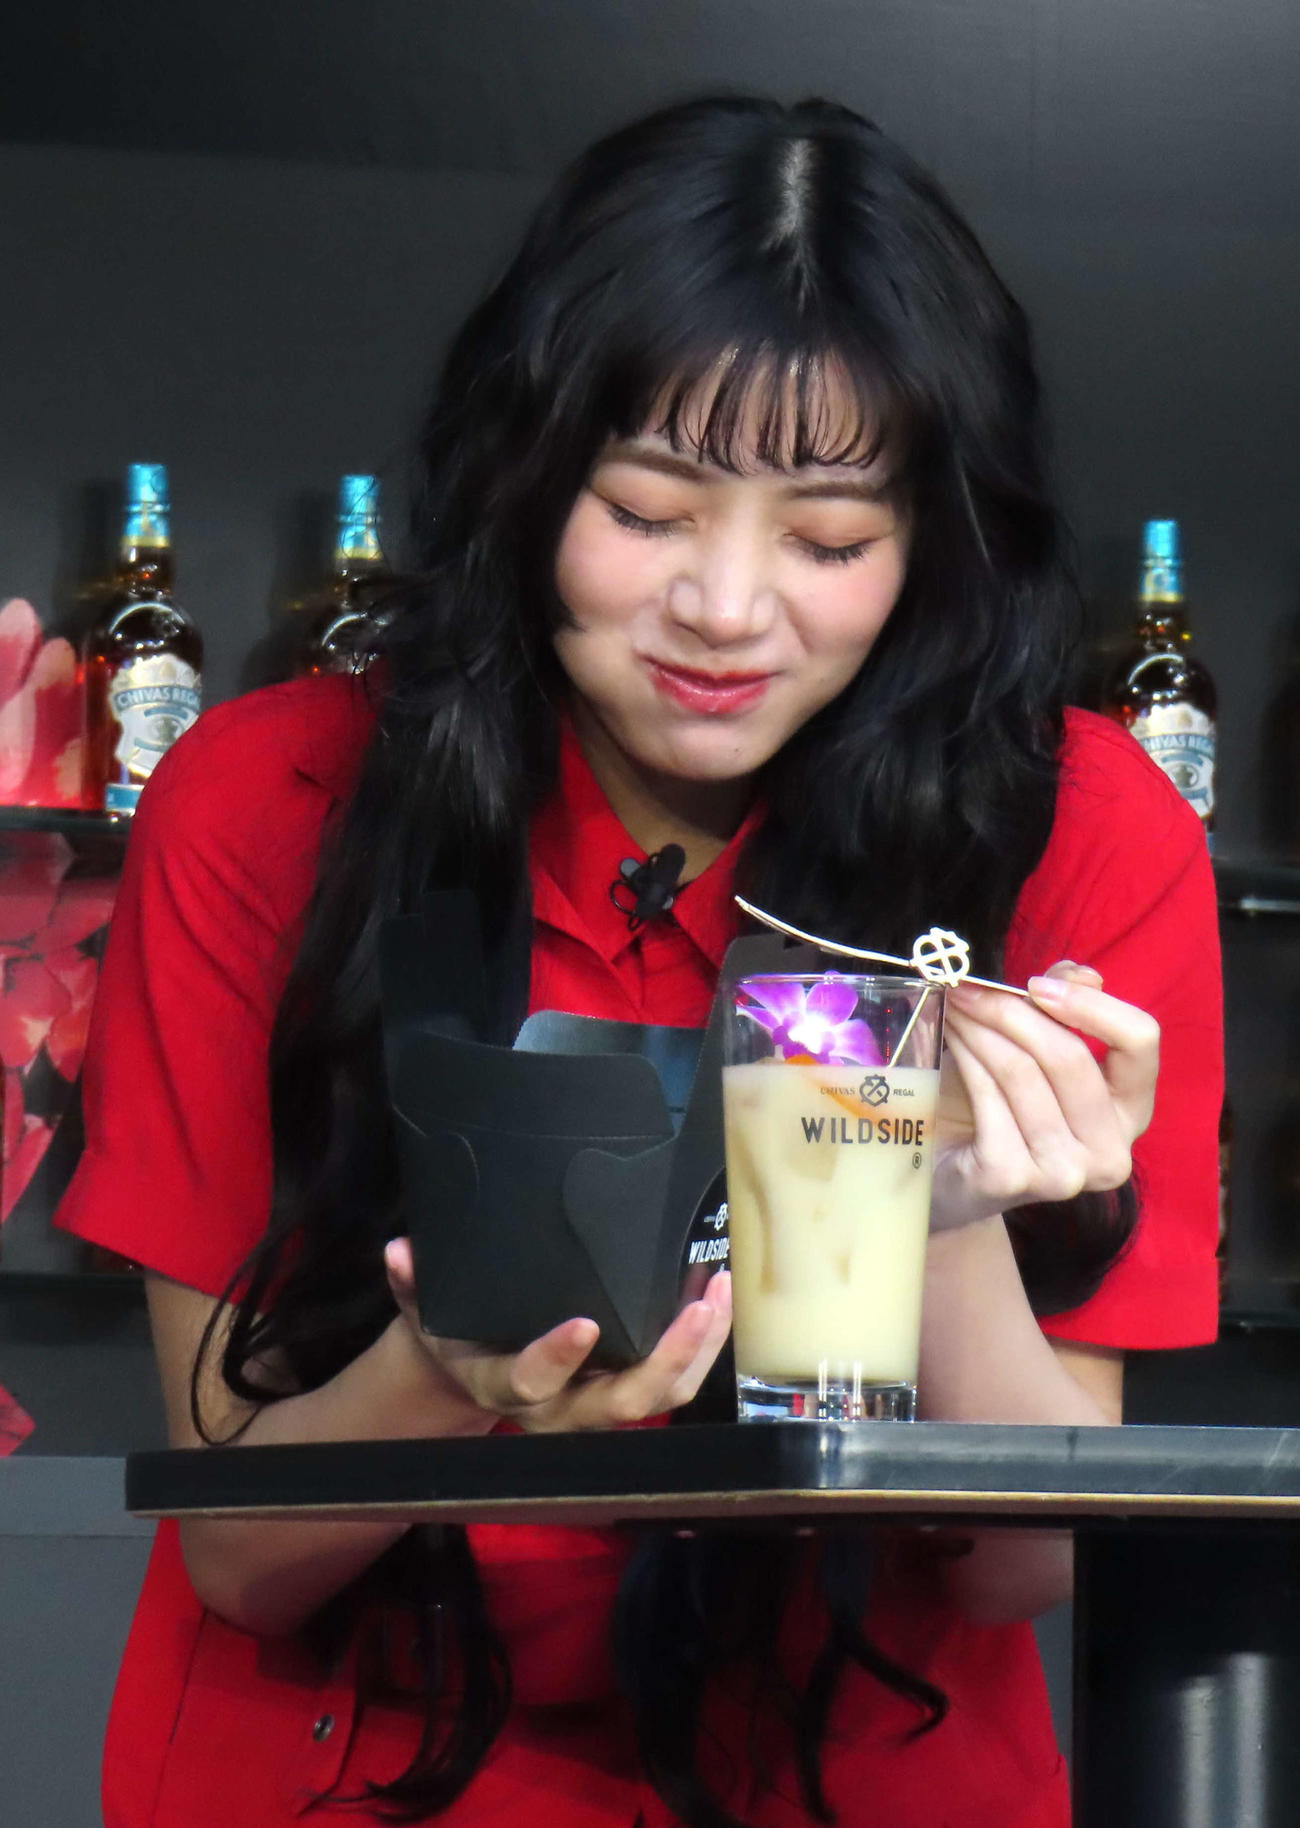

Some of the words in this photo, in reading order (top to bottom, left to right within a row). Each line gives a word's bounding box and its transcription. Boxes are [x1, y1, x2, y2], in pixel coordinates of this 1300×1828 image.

[117, 687, 170, 706] CHIVAS
[820, 1086, 856, 1096] CHIVAS
[893, 1088, 915, 1097] REGAL
[801, 1116, 925, 1146] WILDSIDE
